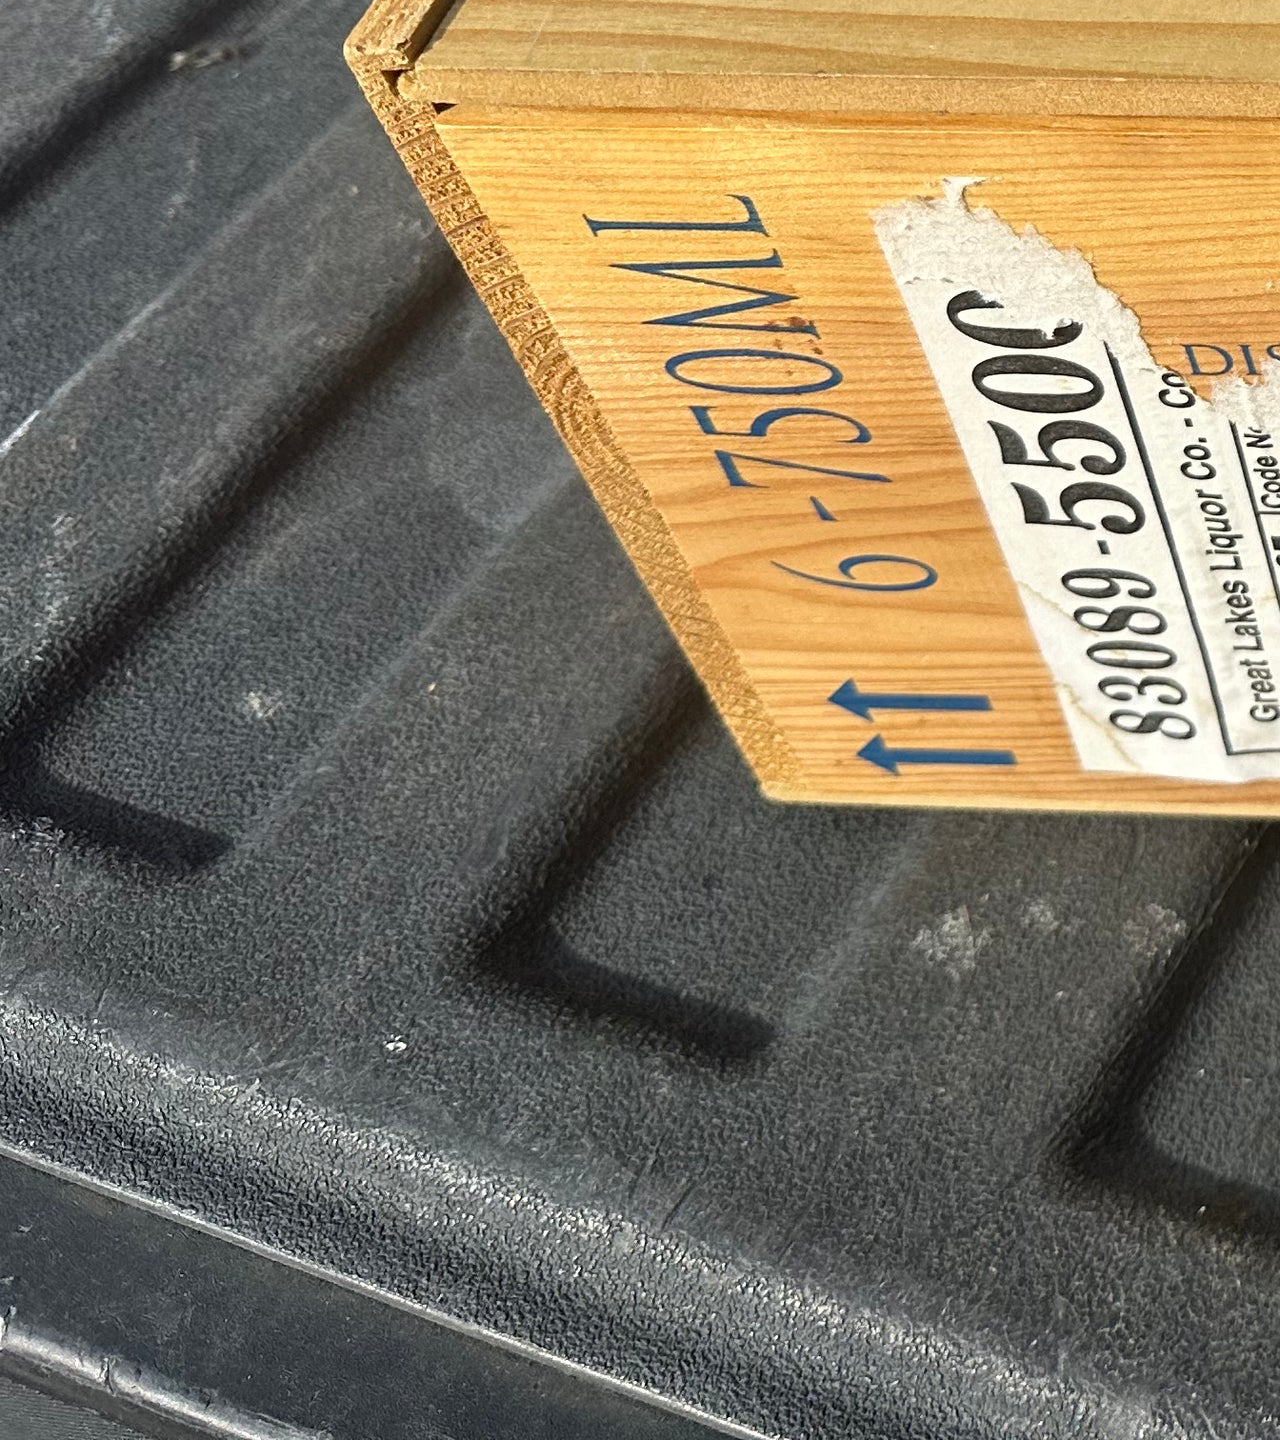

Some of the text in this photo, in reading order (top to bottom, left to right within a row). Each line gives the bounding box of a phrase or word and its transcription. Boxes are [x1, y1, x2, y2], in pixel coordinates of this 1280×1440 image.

[1158, 373, 1196, 408] Co
[1180, 437, 1216, 480] Co.
[1195, 489, 1243, 571] Liquor
[1223, 579, 1265, 651] Lakes
